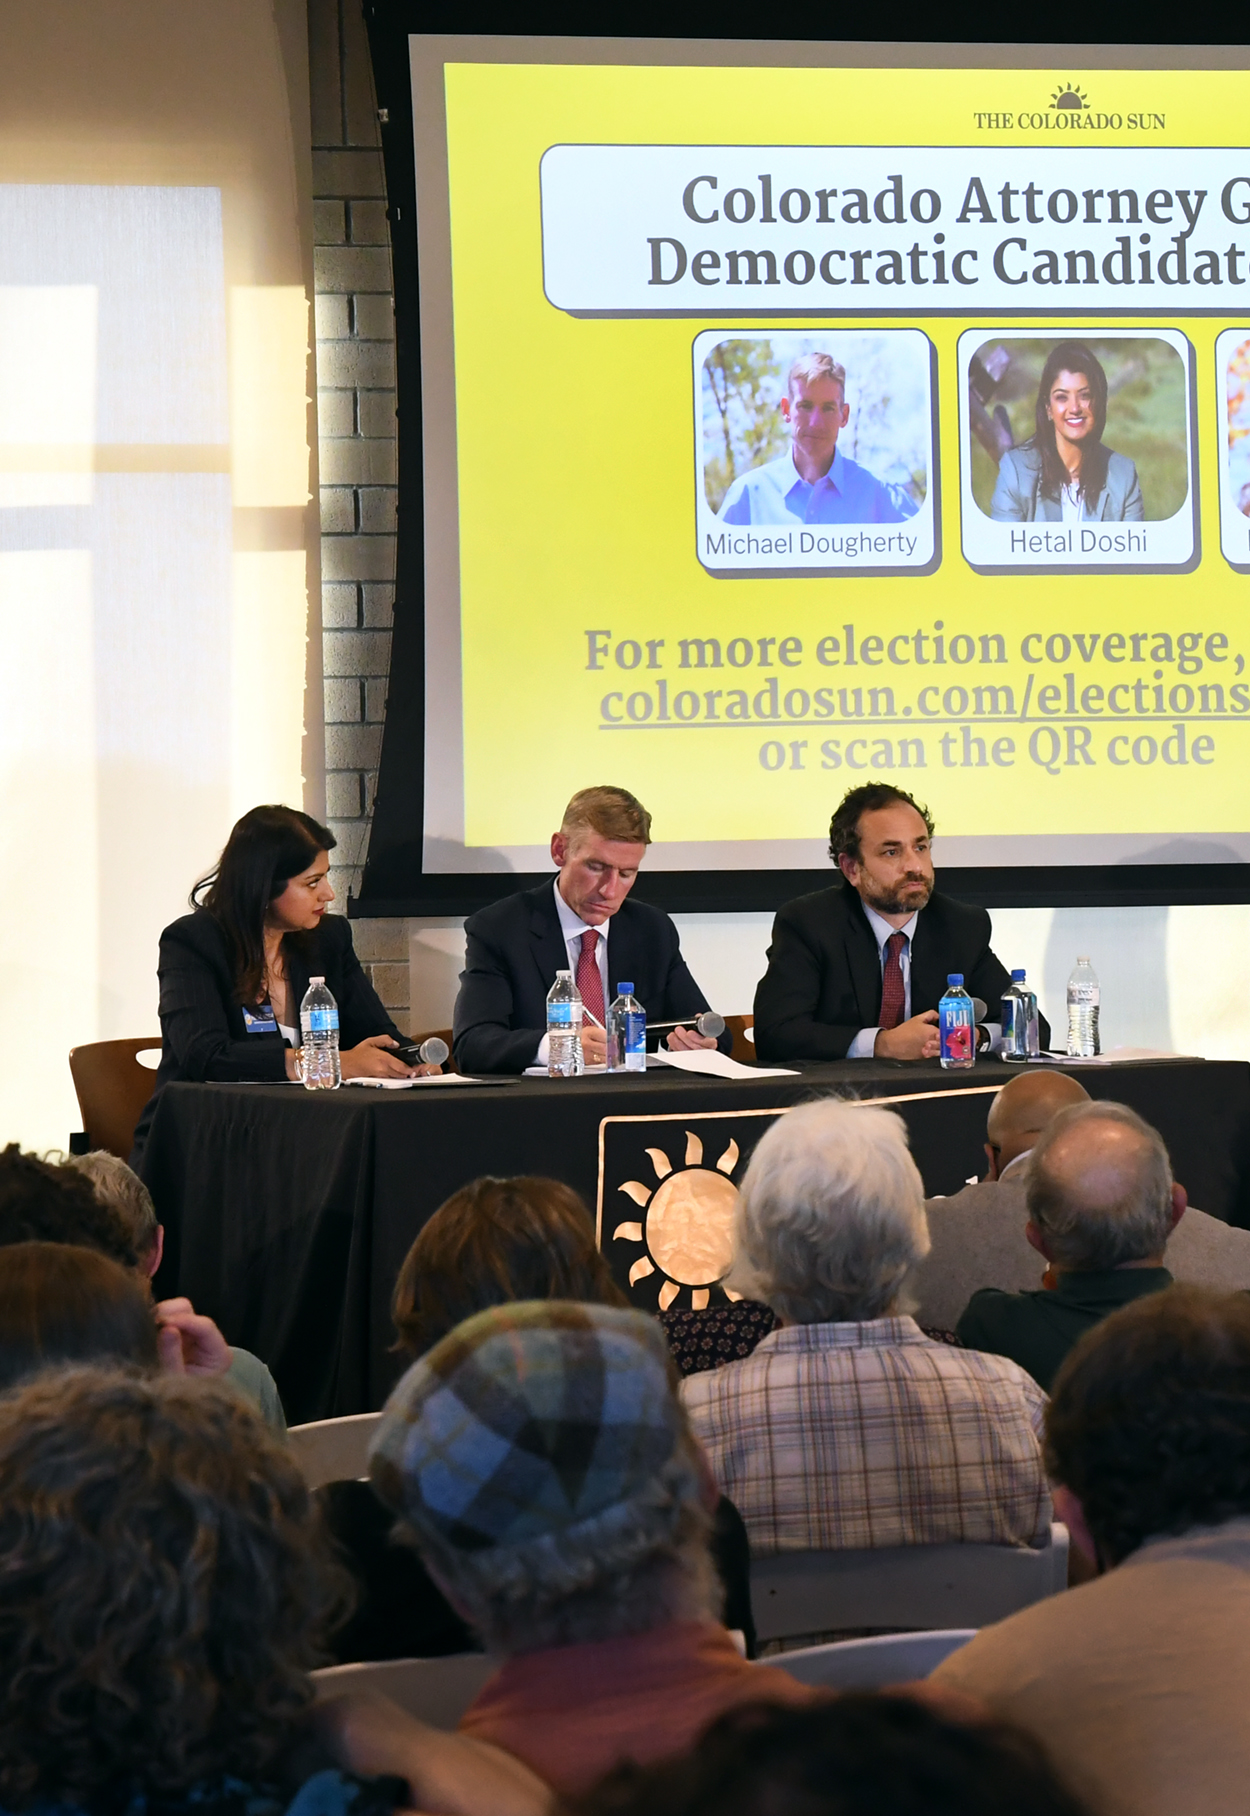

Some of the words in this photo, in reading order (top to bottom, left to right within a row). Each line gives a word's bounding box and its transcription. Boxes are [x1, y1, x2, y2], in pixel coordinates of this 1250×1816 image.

[974, 112, 1013, 130] THE
[1017, 112, 1123, 130] COLORADO
[1127, 112, 1166, 130] SUN
[682, 174, 942, 225] Colorado
[956, 177, 1207, 238] Attorney
[647, 233, 979, 286] Democratic
[706, 532, 793, 555] Michael
[800, 532, 917, 557] Dougherty
[1010, 530, 1075, 553] Hetal
[1081, 529, 1147, 553] Doshi
[584, 630, 665, 671] For
[678, 636, 803, 668] more
[816, 620, 1008, 666] election
[1020, 627, 1245, 675] coverage,
[758, 738, 808, 771] or
[820, 737, 927, 769] scan
[939, 726, 1017, 767] the
[1028, 725, 1096, 775] QR
[1106, 723, 1216, 765] code
[946, 1010, 968, 1027] FIJI
